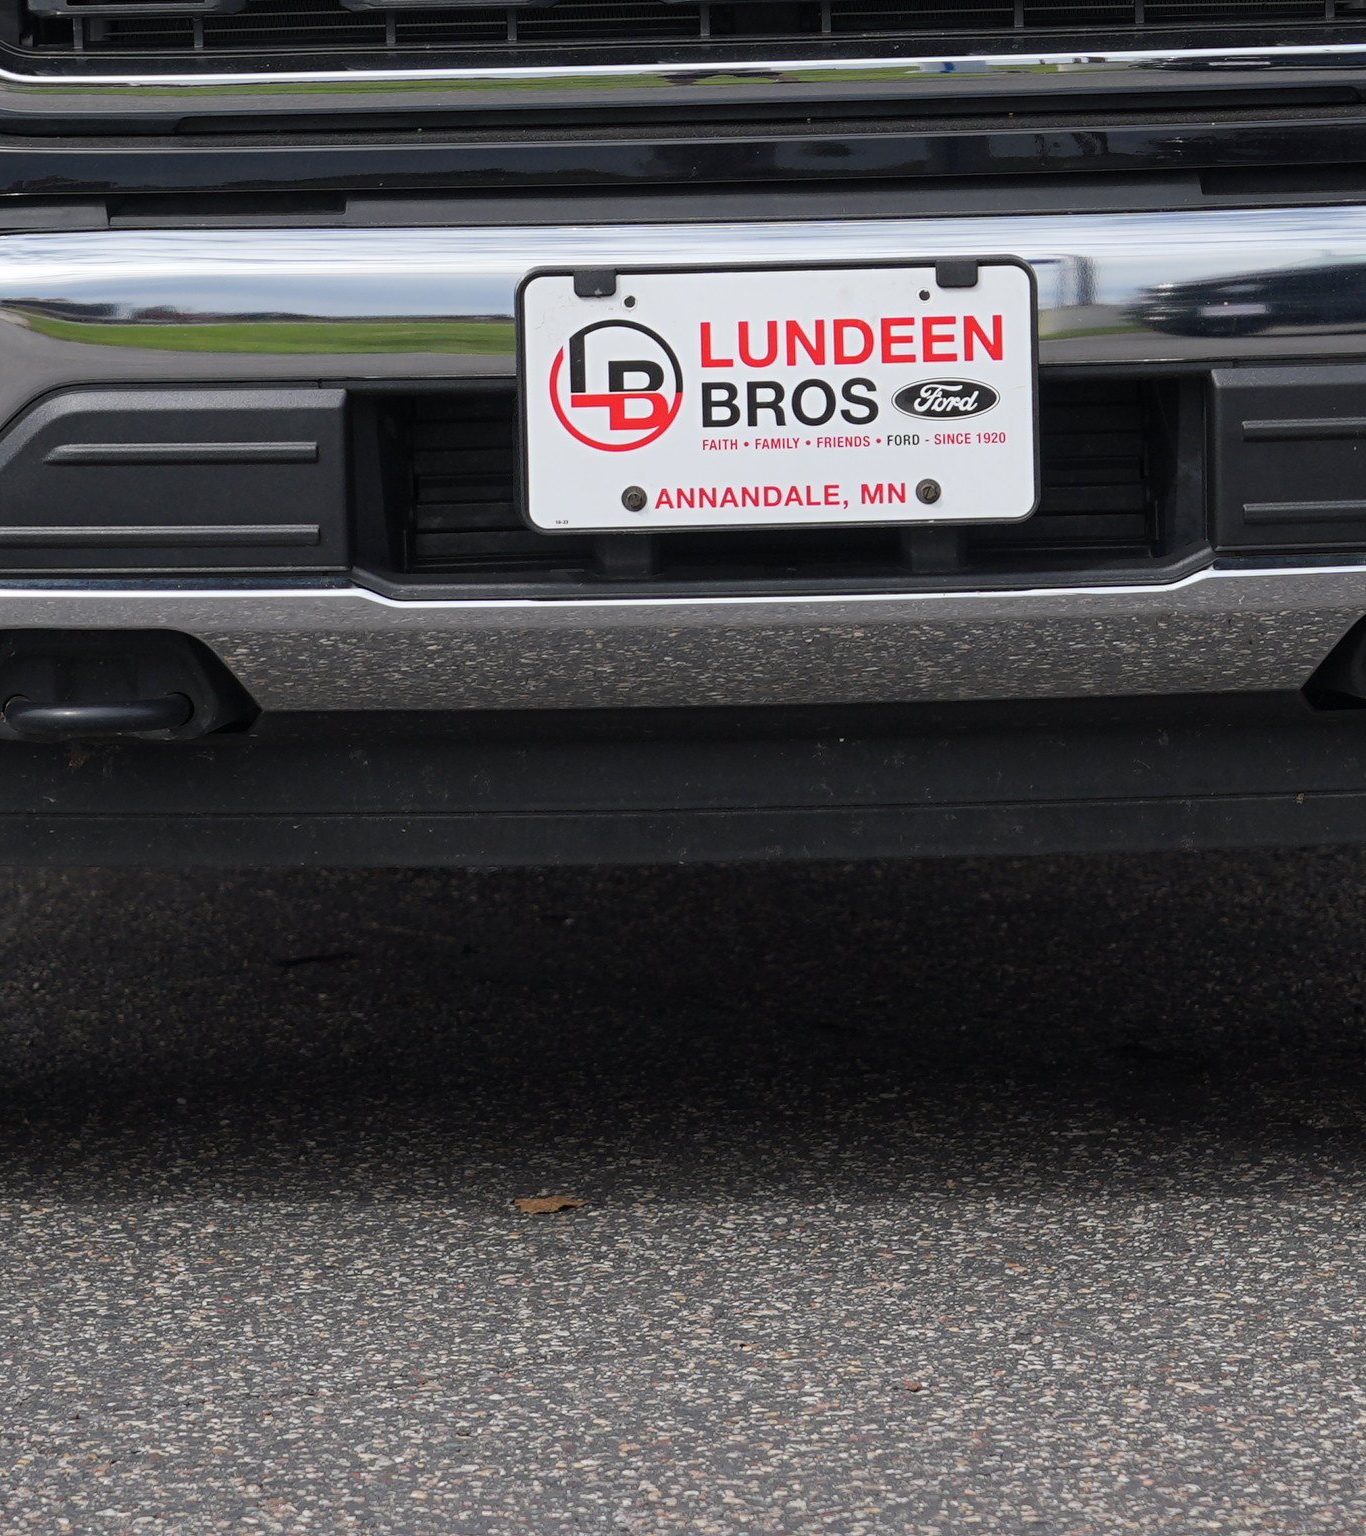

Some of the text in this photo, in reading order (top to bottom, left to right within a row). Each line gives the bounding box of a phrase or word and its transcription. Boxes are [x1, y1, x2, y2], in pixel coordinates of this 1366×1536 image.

[699, 314, 1003, 369] LUNDEEN
[700, 376, 879, 429] BROS
[913, 384, 980, 413] Ford
[701, 431, 1007, 451] FAITH FAMILY FRIENDS FORD SINCE 1920
[654, 482, 907, 511] ANNANDALE, MN
